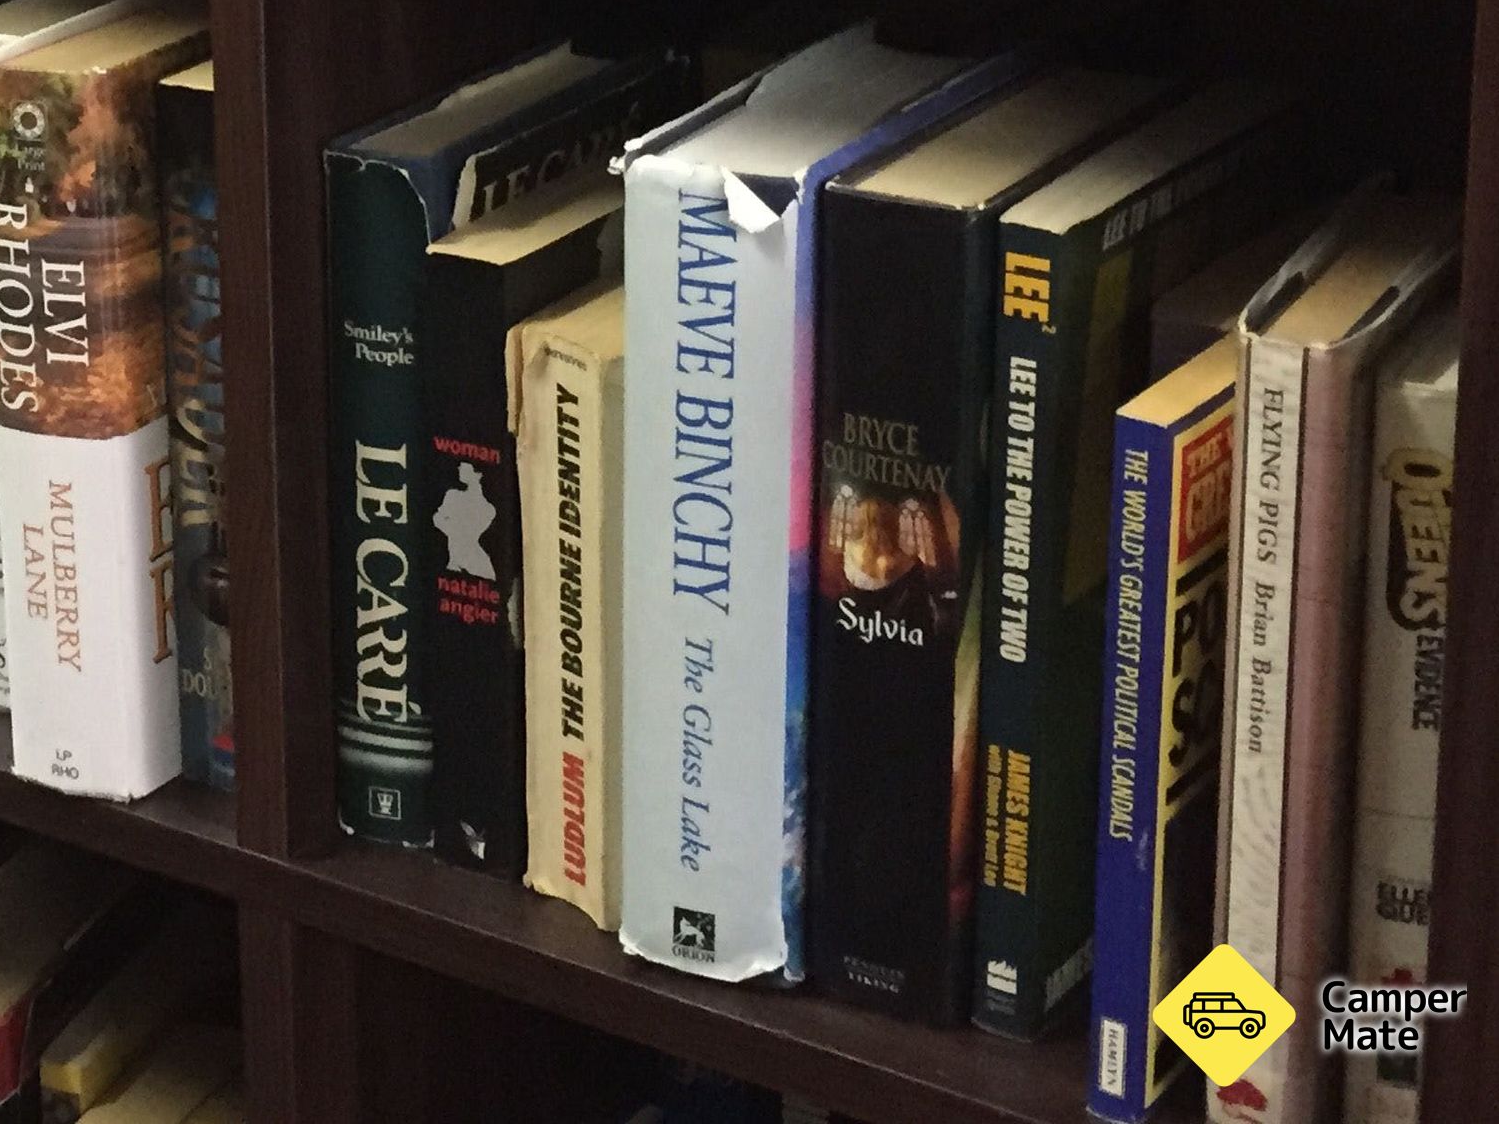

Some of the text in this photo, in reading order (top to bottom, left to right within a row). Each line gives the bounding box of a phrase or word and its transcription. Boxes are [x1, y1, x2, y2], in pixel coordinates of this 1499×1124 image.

[41, 258, 90, 368] ELVI
[343, 320, 414, 345] Smiley's
[354, 343, 415, 368] People
[432, 434, 500, 464] woman
[672, 187, 738, 616] MAEVE BINCHY
[842, 412, 919, 458] BRYCE
[556, 382, 582, 549] IDENTITY
[821, 439, 951, 494] COURTENAY
[999, 355, 1038, 664] LEE TO THE POWER OF TWO
[22, 522, 49, 622] LANE
[48, 478, 83, 673] MULBERRY
[355, 440, 423, 724] LE CARRÉ
[436, 576, 501, 603] natalie
[438, 598, 499, 626] angier
[558, 552, 583, 673] BOURNE
[1246, 387, 1285, 754] FLYING PIGS Brian Battison
[836, 597, 925, 647] Sylvia
[1108, 448, 1149, 843] THE WORLD'S GREATEST POLITICAL SCANDALS
[560, 675, 585, 742] THE
[1411, 633, 1445, 731] EVIDENCE
[51, 764, 80, 780] RHO
[680, 636, 714, 873] The Glass Lake
[563, 752, 587, 887] LUDLUM
[1003, 749, 1031, 895] JAMES KNIGHT
[671, 944, 716, 964] ORION
[1105, 1027, 1119, 1087] HAMLYN
